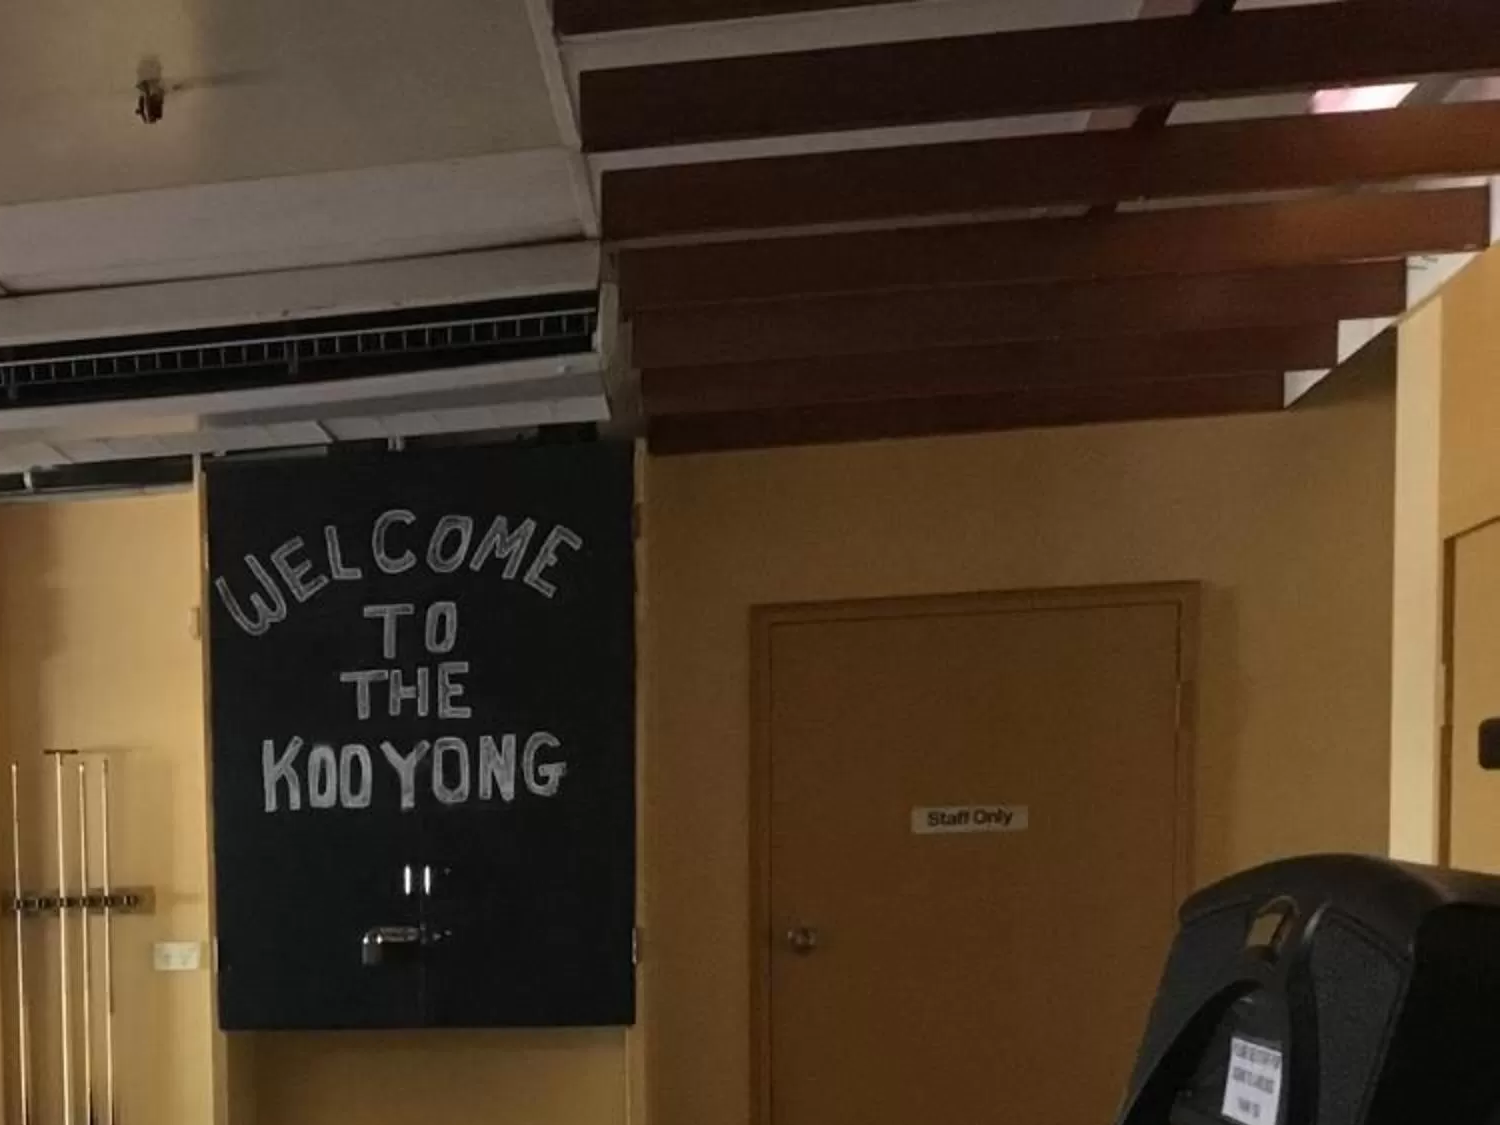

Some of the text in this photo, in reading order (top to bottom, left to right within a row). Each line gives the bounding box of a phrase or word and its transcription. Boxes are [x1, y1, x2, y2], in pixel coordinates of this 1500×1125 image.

[215, 509, 582, 637] WELCOME
[363, 601, 458, 659] TO
[339, 661, 472, 720] THE
[261, 731, 567, 813] KOOYONG
[927, 807, 1014, 827] Staff Only
